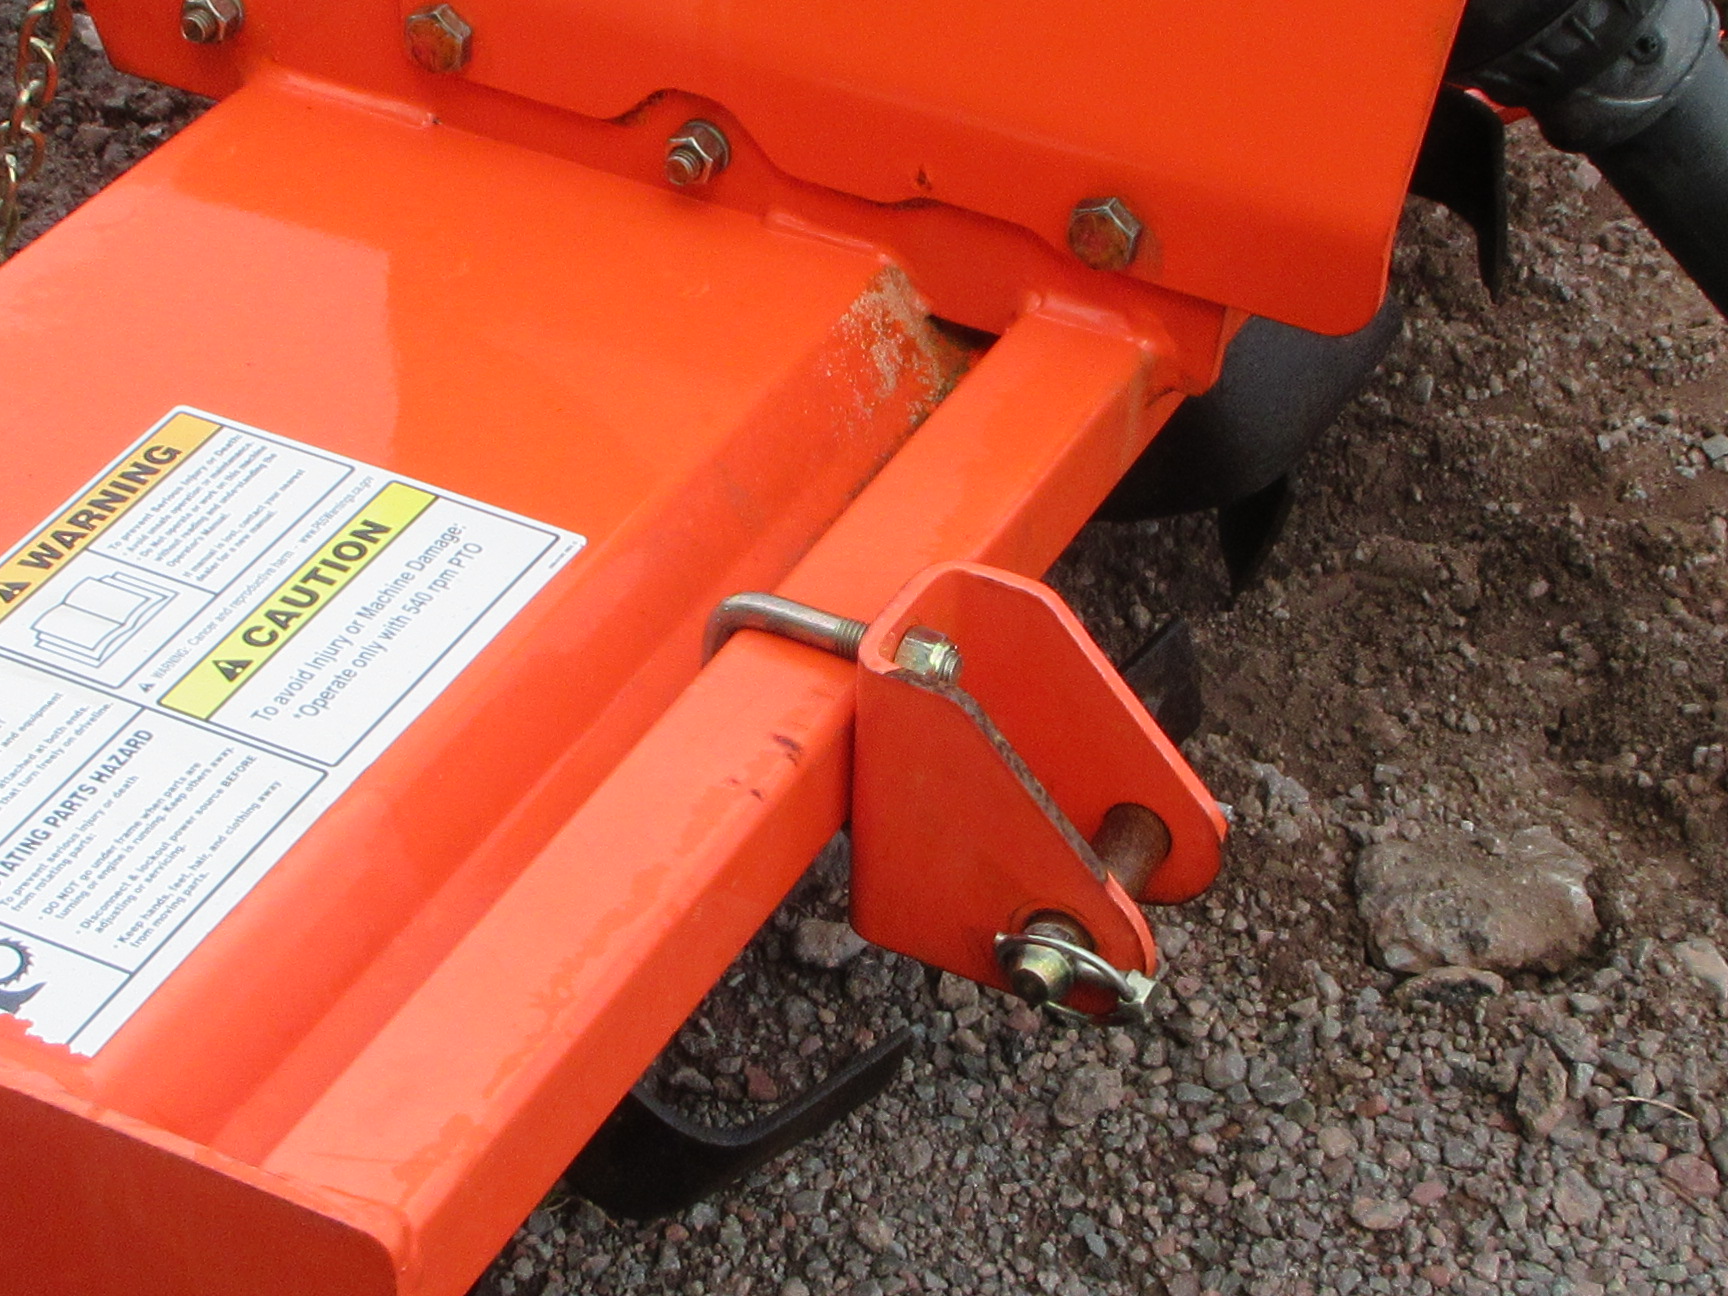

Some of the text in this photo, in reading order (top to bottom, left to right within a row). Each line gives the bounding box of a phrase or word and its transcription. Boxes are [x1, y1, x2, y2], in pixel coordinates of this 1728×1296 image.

[18, 443, 182, 571] WARNING
[105, 433, 243, 550] To prevent Serious Injury or Death:
[150, 646, 192, 679] WARNING:
[186, 620, 219, 646] Cancer
[213, 606, 234, 622] and
[227, 566, 278, 609] reproductive
[269, 549, 296, 569] harm
[238, 519, 393, 648] CAUTION
[249, 522, 469, 722] To avoid Injury or Machine Damage:
[348, 639, 389, 669] only
[375, 614, 415, 642] with
[400, 590, 437, 616] 540
[424, 567, 461, 594] rpm
[446, 541, 486, 569] PTO
[16, 691, 65, 732] equipment
[16, 769, 42, 788] turn
[34, 746, 66, 770] freely
[60, 735, 78, 748] on
[71, 700, 115, 737] driveline.
[33, 743, 49, 754] at
[41, 725, 69, 745] both
[63, 704, 91, 726] ends.
[10, 862, 49, 896] prevent
[44, 831, 81, 863] serious
[74, 808, 106, 833] injury
[100, 798, 115, 809] or
[110, 774, 140, 799] death
[41, 782, 99, 829] PARTS
[87, 728, 155, 784] HAZARD
[41, 761, 203, 916] DO NOT go under frame when parts are
[53, 746, 236, 920] turning or engine is running. Keep others away.
[9, 832, 98, 912] from rotating parts:
[79, 754, 258, 930] Disconnect & lockout power source BEFORE
[93, 840, 187, 935] adjusting or servicing.
[115, 780, 283, 944] Keep hands, feet, hair, and clothing away
[128, 870, 211, 948] from moving parts.
